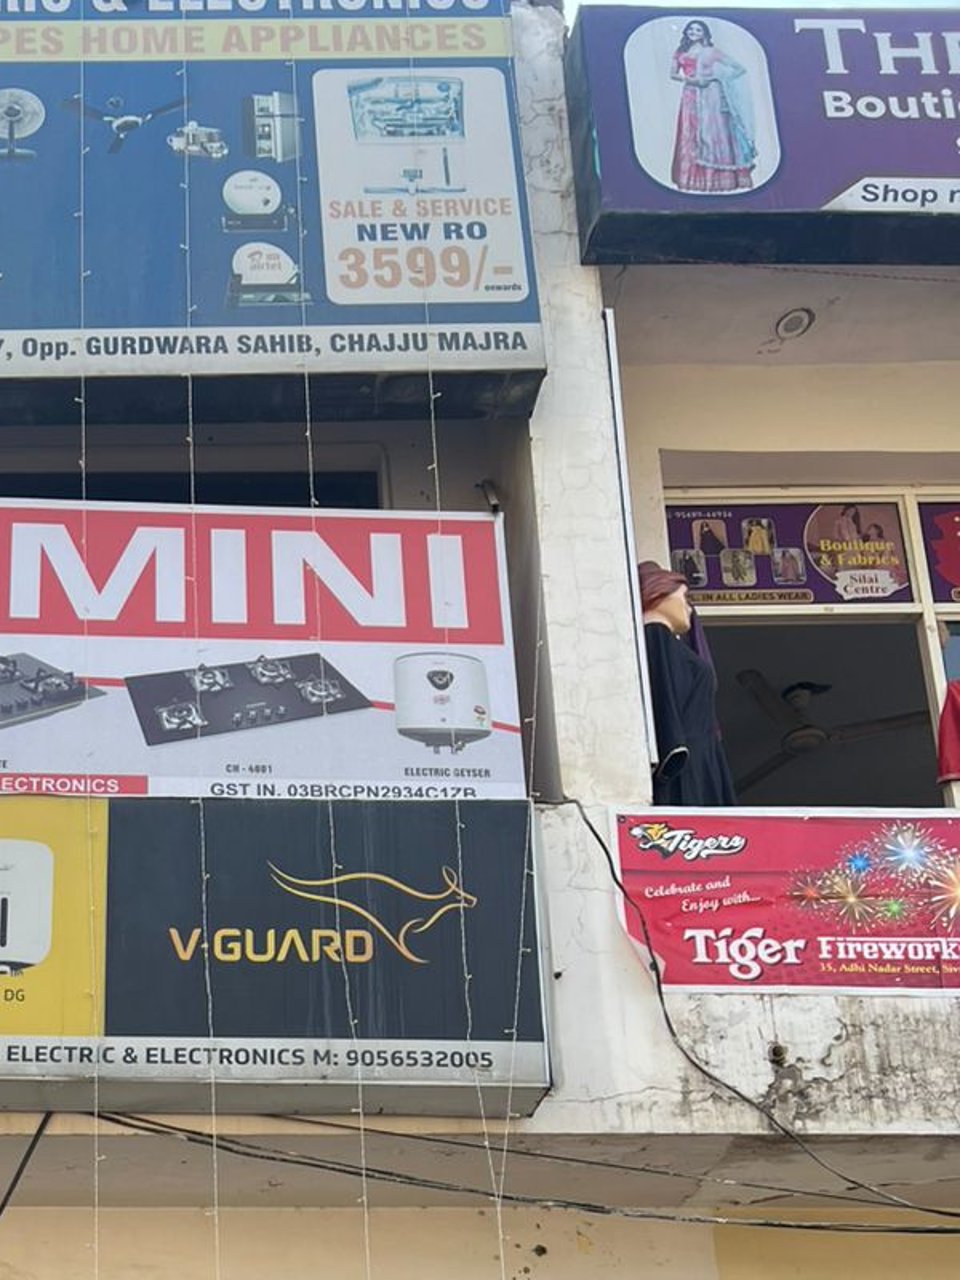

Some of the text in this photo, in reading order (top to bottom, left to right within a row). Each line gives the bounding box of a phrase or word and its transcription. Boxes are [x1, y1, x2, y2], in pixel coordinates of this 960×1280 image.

[82, 25, 206, 54] HOME
[221, 23, 487, 54] APPLIANCES
[823, 88, 960, 119] Bouti
[861, 183, 938, 207] Shop
[329, 197, 513, 219] SALE & SERVICE
[357, 221, 487, 242] NEW RO
[22, 337, 77, 362] Opp.
[85, 333, 228, 357] GURDWARA
[237, 333, 321, 357] SAHIB,
[330, 332, 428, 353] CHAJJU
[438, 331, 527, 352] MAJRA
[404, 767, 491, 779] ELECTRIC GEYSER
[210, 783, 250, 796] GST
[644, 877, 731, 899] Celebrate and
[681, 898, 719, 915] Enjoy
[684, 927, 806, 981] Tiger
[817, 936, 960, 960] Firework
[4, 989, 25, 1003] DG
[7, 1045, 115, 1064] ELECTRIC
[122, 1046, 139, 1064] &
[147, 1046, 306, 1067] ELECTRONICS
[312, 1048, 340, 1067] M:
[346, 1049, 494, 1069] 9056532005
